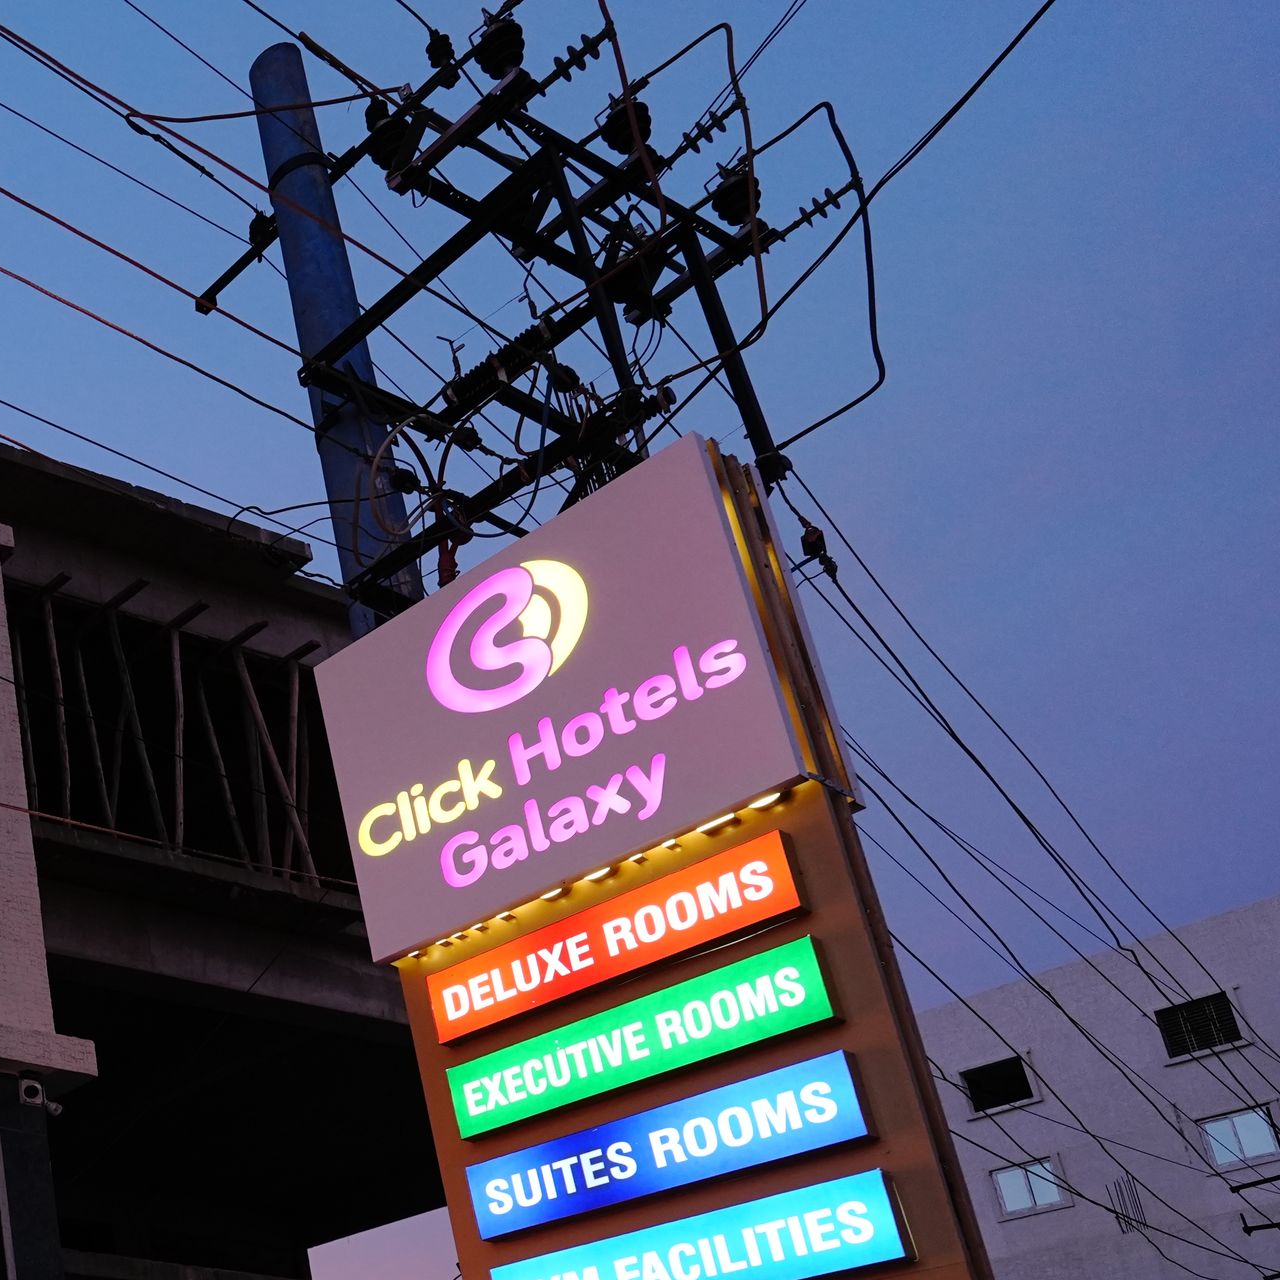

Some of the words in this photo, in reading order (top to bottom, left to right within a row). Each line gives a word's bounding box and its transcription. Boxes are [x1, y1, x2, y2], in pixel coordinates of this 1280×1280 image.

[358, 758, 503, 857] Click
[508, 639, 747, 785] Hotels
[440, 753, 666, 888] Galaxy
[442, 932, 594, 1021] DELUXE
[602, 860, 774, 957] ROOMS
[463, 1021, 649, 1117] EXECUTIVE
[662, 966, 806, 1051] ROOMS
[485, 1141, 638, 1216] SUITES
[648, 1081, 838, 1168] ROOMS
